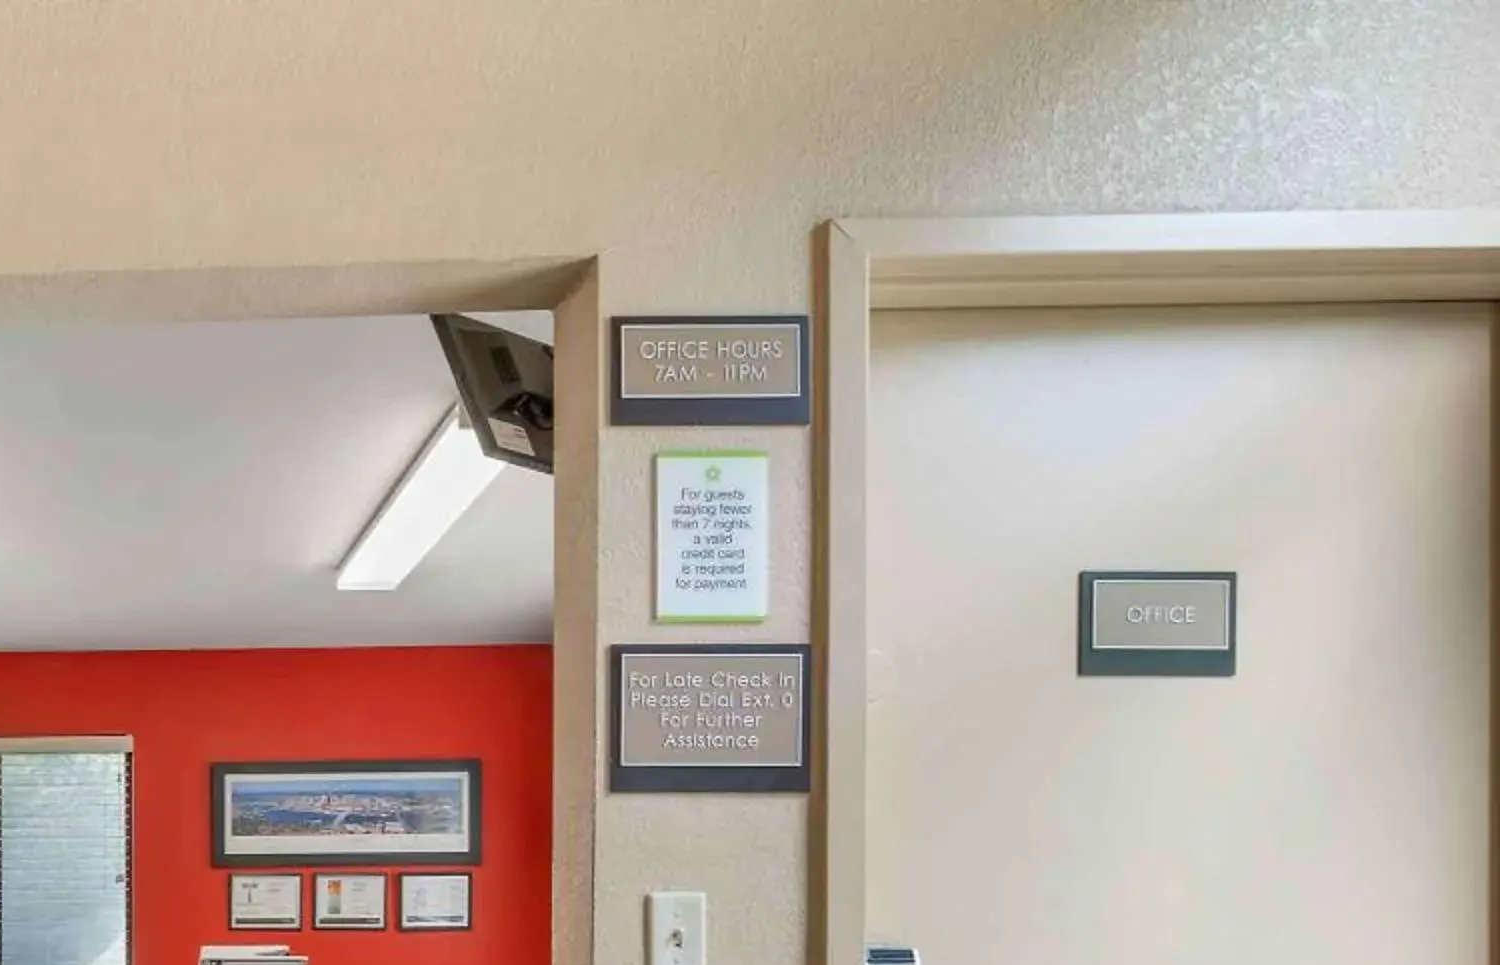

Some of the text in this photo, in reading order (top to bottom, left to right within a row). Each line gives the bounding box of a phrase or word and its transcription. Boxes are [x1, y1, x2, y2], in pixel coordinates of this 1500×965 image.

[639, 340, 783, 360] OFFICE HOURS
[654, 363, 697, 383] 7AM
[723, 363, 768, 383] 11PM
[681, 487, 744, 502] For guests
[673, 504, 753, 517] staying fewer
[671, 519, 699, 529] than
[702, 519, 711, 529] 7
[693, 533, 733, 545] a valid
[681, 548, 745, 560] credit card
[681, 563, 745, 576] is required
[675, 578, 747, 592] for payment
[1126, 605, 1197, 624] OFFICE
[629, 670, 796, 689] For Late Check In
[630, 690, 691, 708] Please
[699, 691, 735, 708] Dial
[741, 691, 774, 708] Ext.
[660, 711, 762, 728] For Further
[662, 731, 760, 749] Assistance
